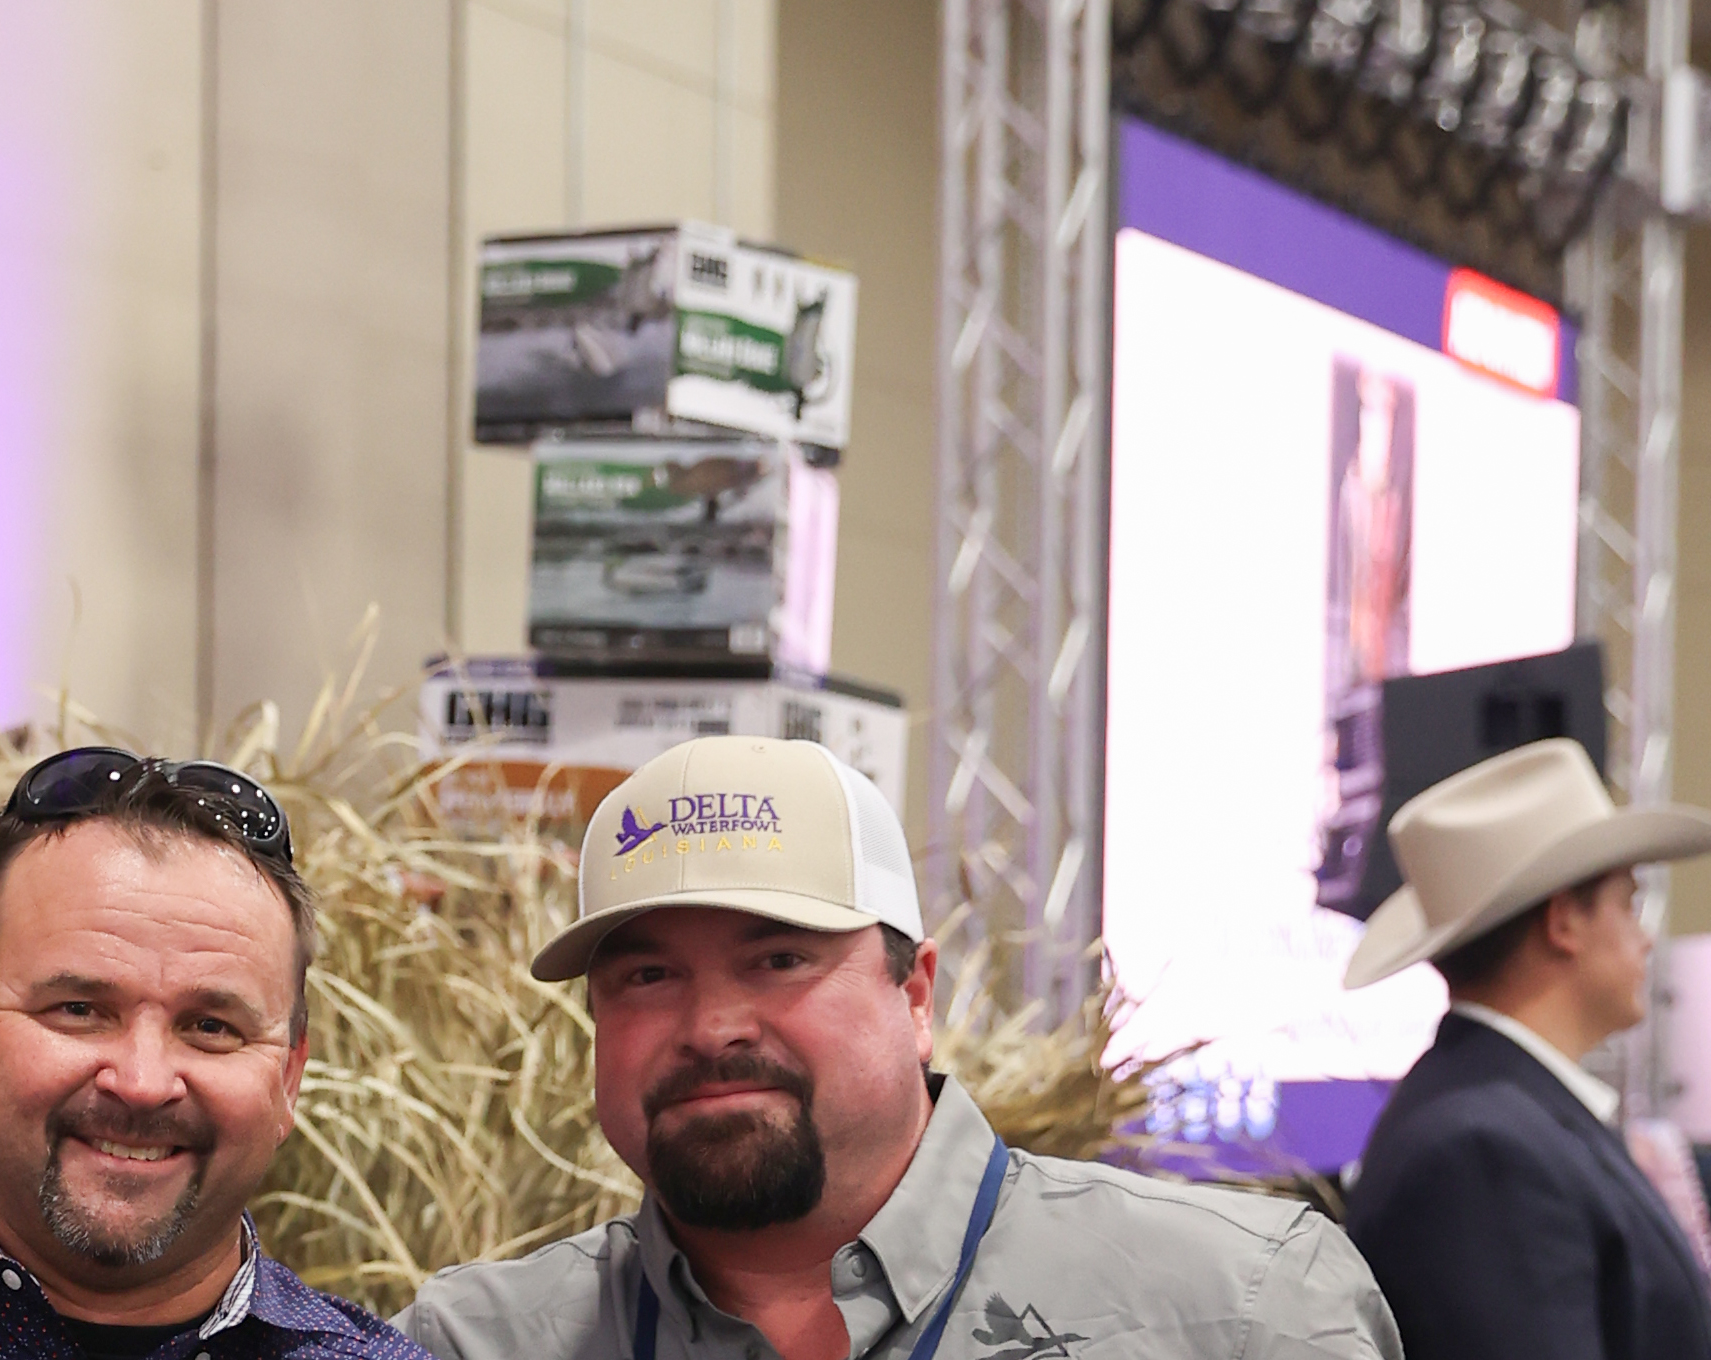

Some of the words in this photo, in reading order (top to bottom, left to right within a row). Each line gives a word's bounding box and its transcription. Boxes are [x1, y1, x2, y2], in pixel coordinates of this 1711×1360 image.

[668, 793, 780, 823] DELTA
[671, 820, 782, 836] WATERFOWL
[611, 834, 783, 880] LOUISIANA
